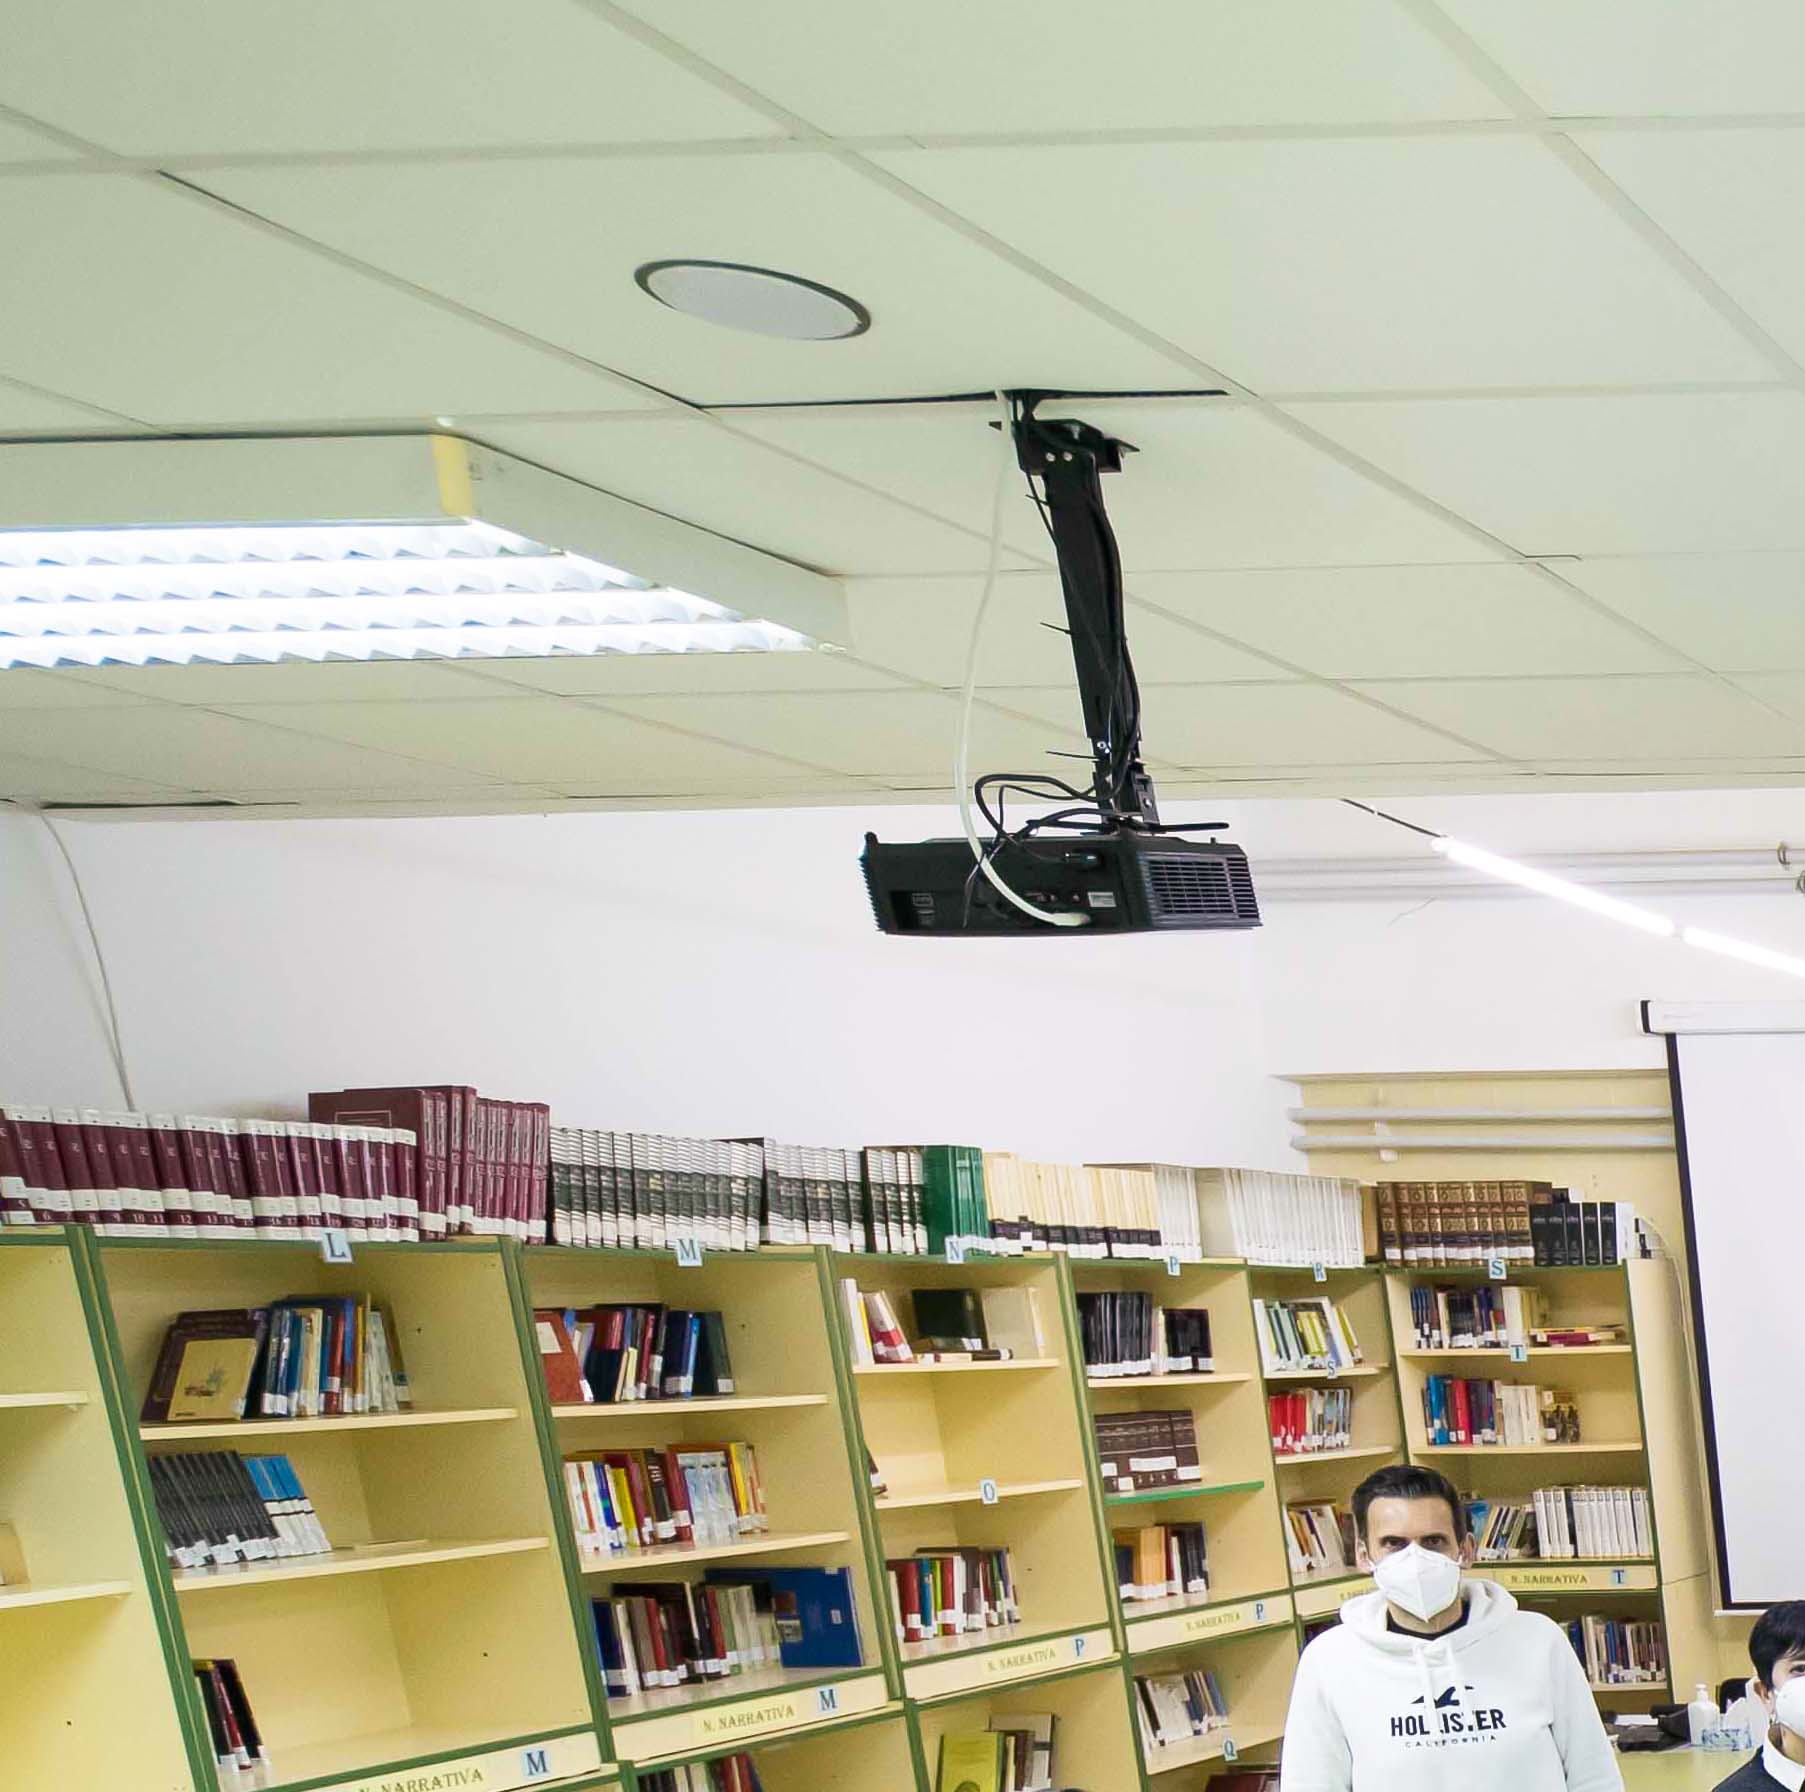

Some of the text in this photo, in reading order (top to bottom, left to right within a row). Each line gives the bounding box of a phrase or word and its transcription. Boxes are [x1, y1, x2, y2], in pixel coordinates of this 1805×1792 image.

[179, 1214, 192, 1224] 12
[325, 1233, 347, 1257] L
[677, 1238, 696, 1260] M
[949, 1240, 960, 1260] N
[1169, 1255, 1178, 1272] P
[1315, 1262, 1324, 1279] R
[1491, 1260, 1503, 1276] S
[1510, 1344, 1523, 1360] T
[983, 1482, 995, 1501] O
[1612, 1569, 1625, 1584] T
[1256, 1603, 1264, 1620] P
[1075, 1638, 1085, 1656] P
[819, 1688, 837, 1712] M
[719, 1704, 795, 1729] NARRATIVA
[1390, 1708, 1507, 1738] HOLISER
[526, 1749, 548, 1776] M
